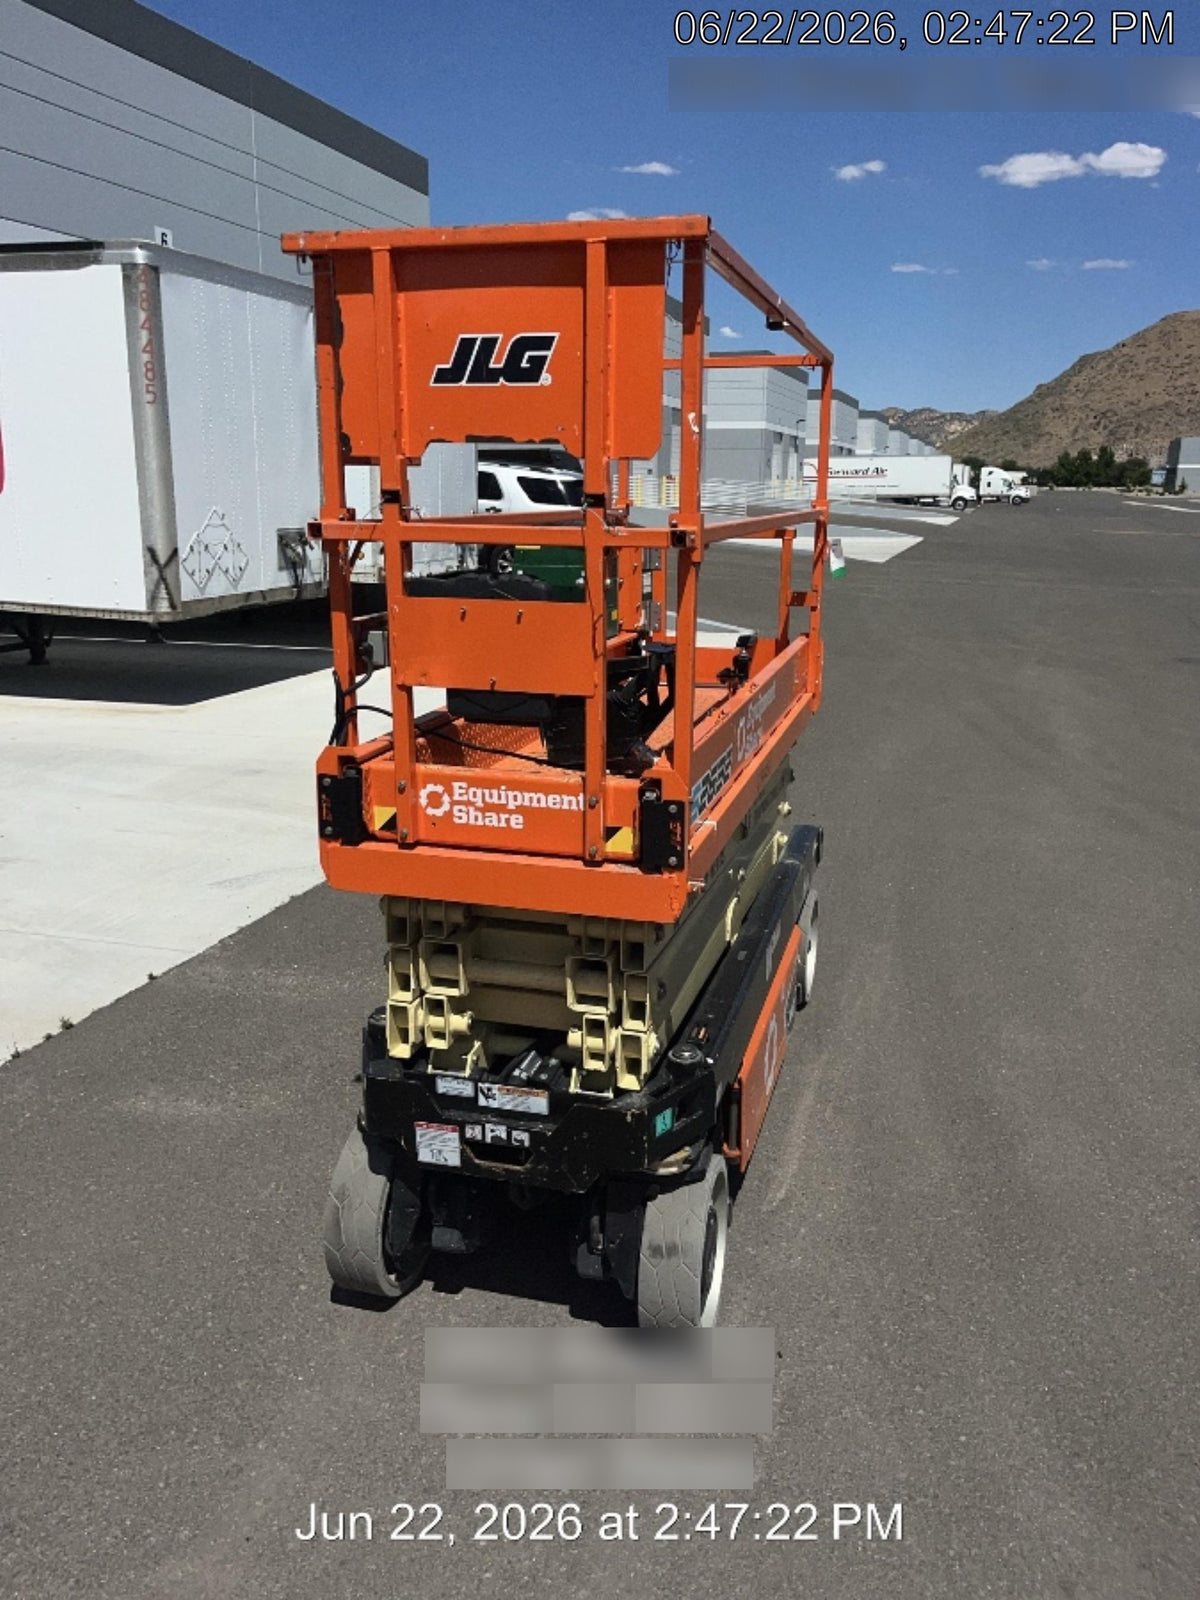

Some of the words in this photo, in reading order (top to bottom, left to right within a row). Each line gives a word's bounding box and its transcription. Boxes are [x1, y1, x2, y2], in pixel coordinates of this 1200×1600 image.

[430, 332, 560, 386] JLG
[451, 782, 585, 811] Equipment
[452, 805, 524, 829] Share
